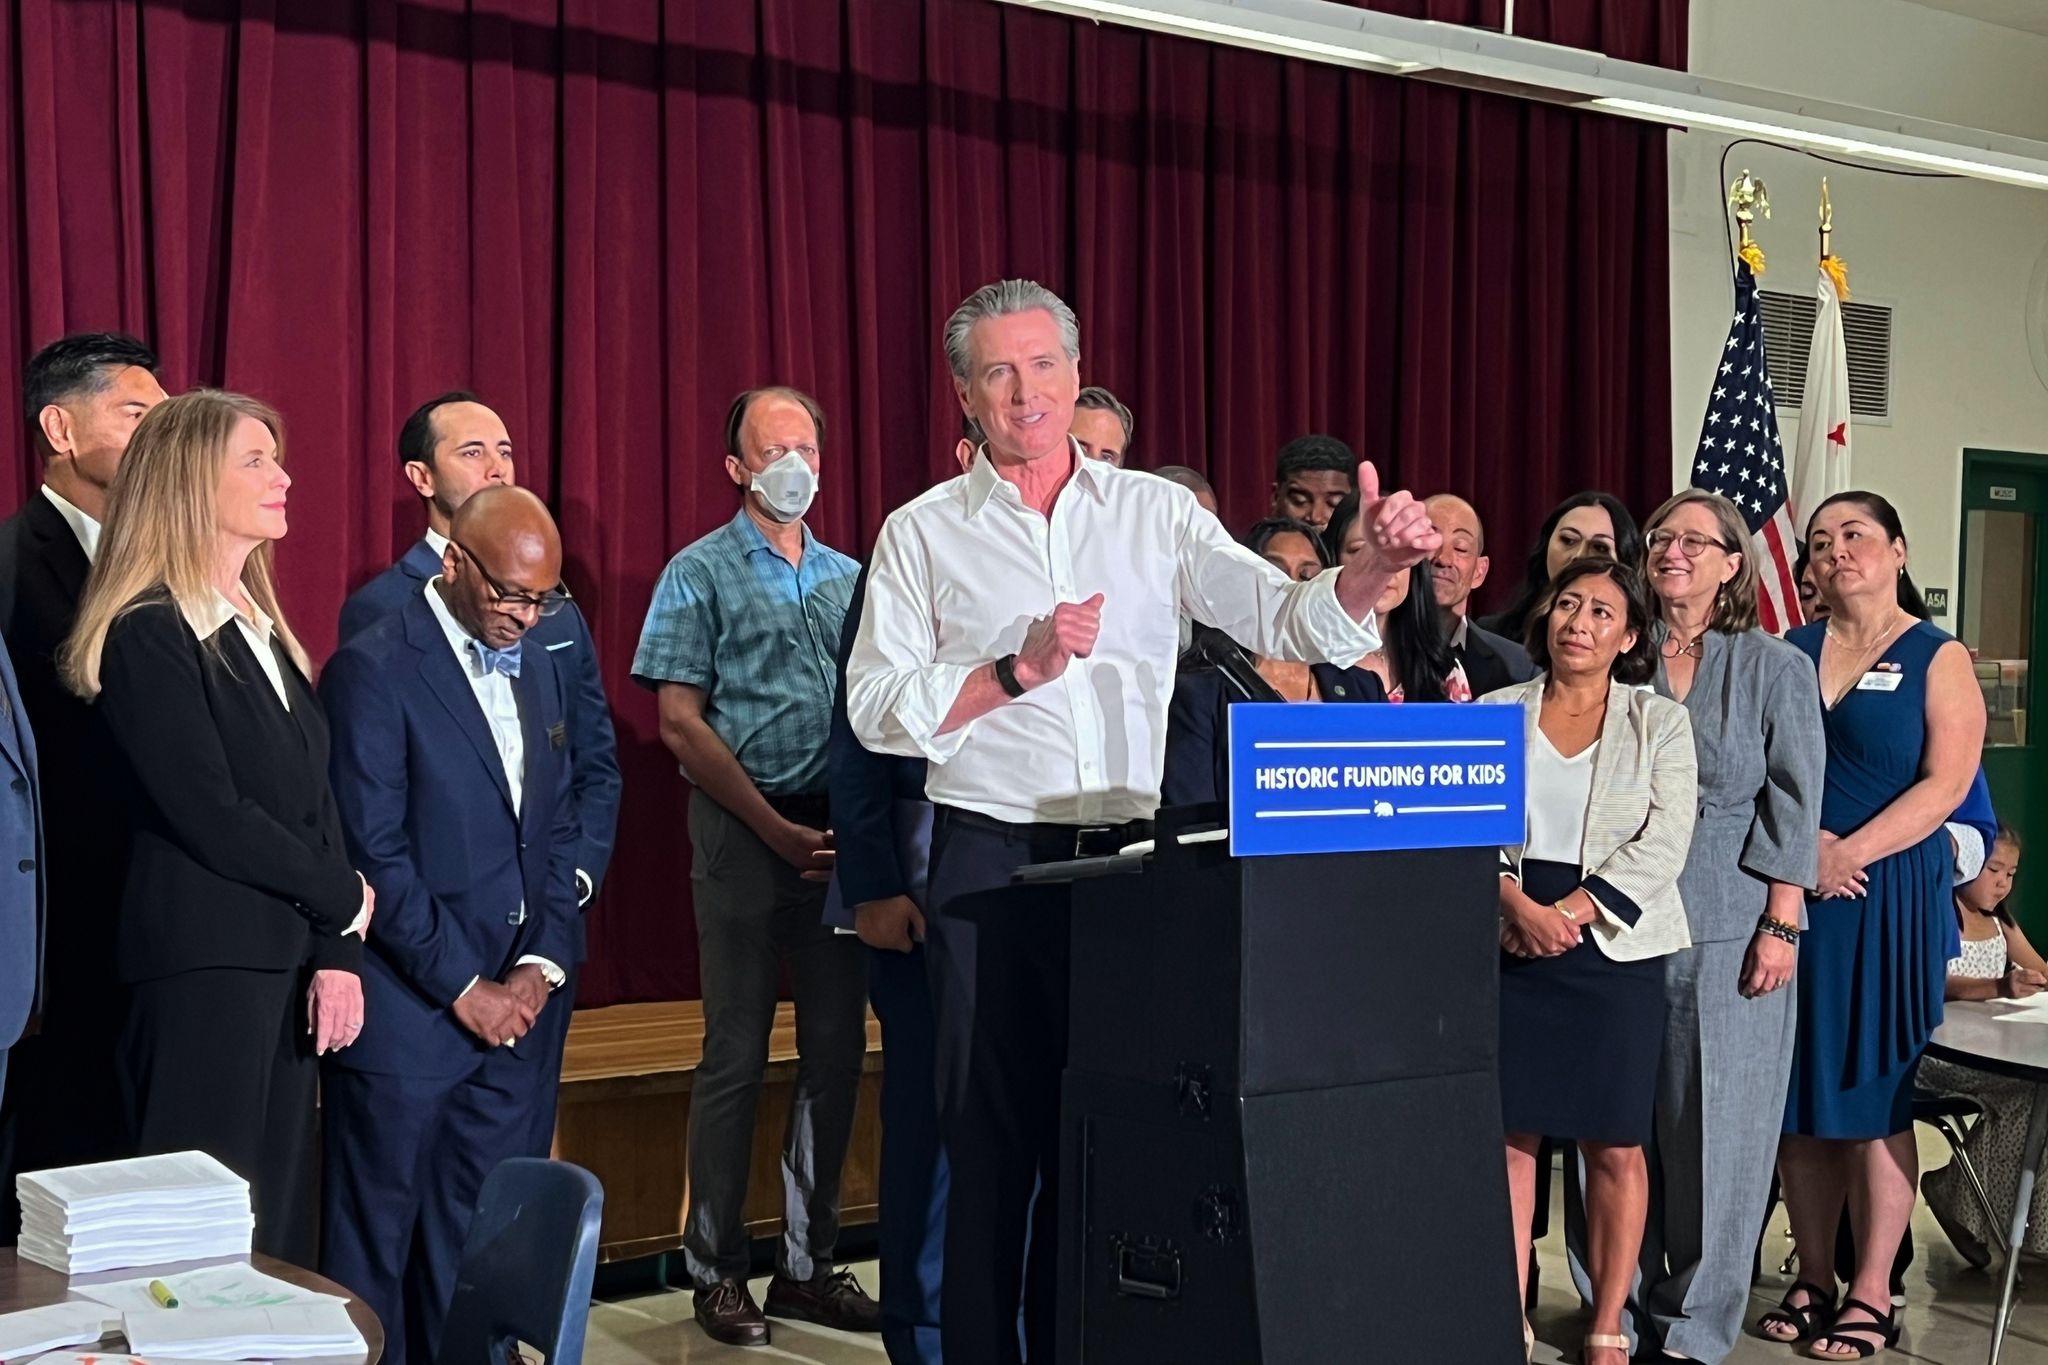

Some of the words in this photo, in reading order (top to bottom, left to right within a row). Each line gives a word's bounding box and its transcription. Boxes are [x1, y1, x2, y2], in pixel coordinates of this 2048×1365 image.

[1256, 767, 1339, 789] HISTORIC
[1344, 764, 1425, 787] FUNDING
[1430, 764, 1464, 785] FOR
[1468, 763, 1507, 784] KIDS
